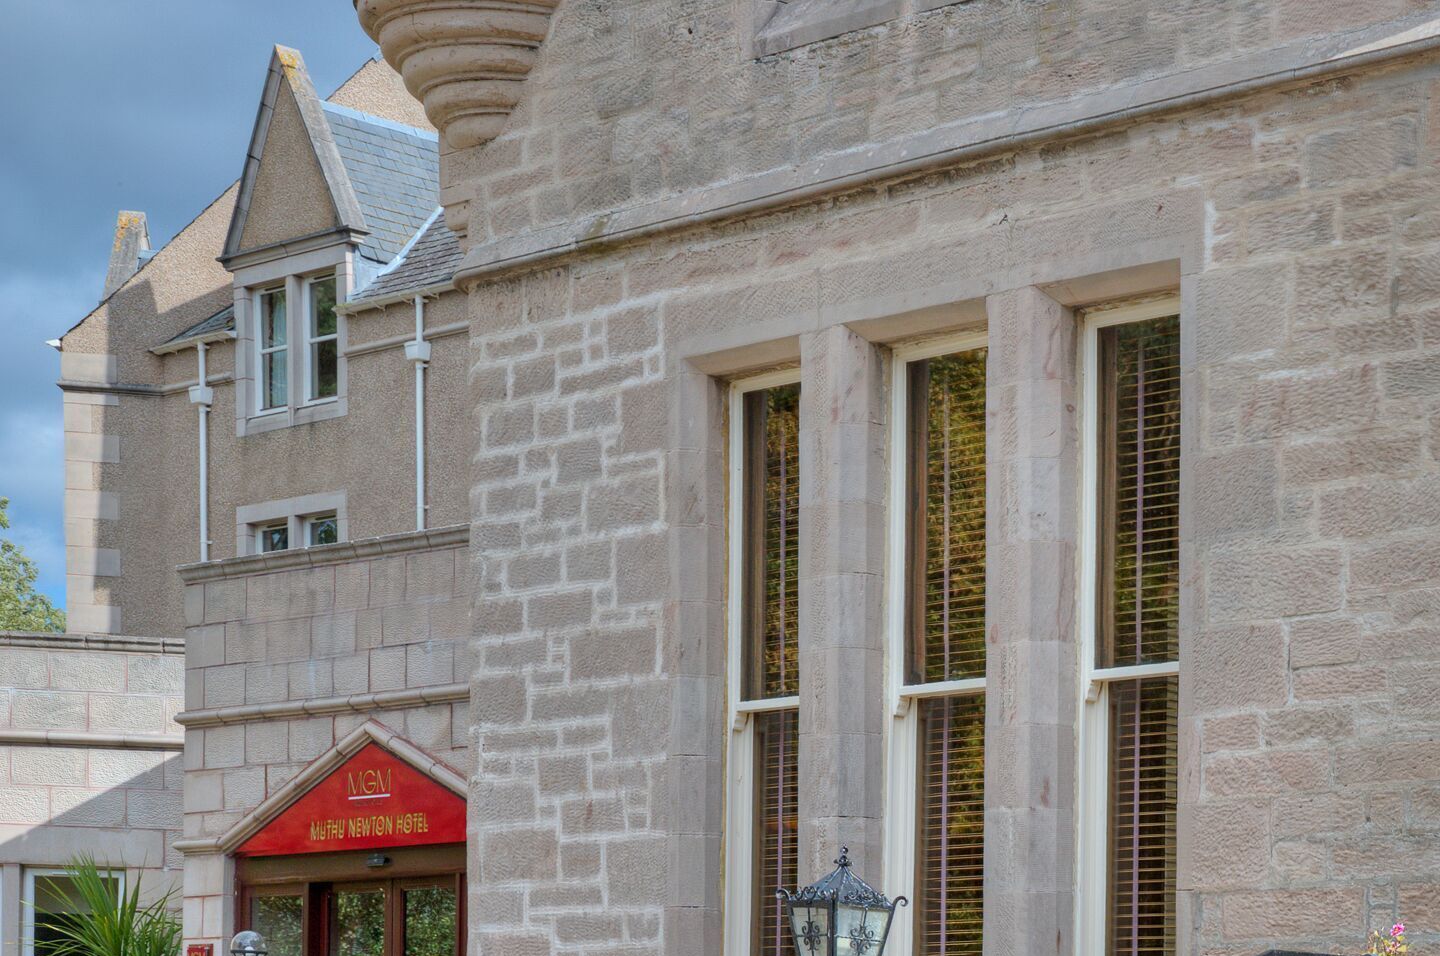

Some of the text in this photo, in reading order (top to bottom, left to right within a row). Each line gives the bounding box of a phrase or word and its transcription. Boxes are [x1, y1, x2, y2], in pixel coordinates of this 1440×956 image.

[348, 768, 391, 795] MGM
[310, 812, 428, 840] MUTHU NEWTON HOTEL
